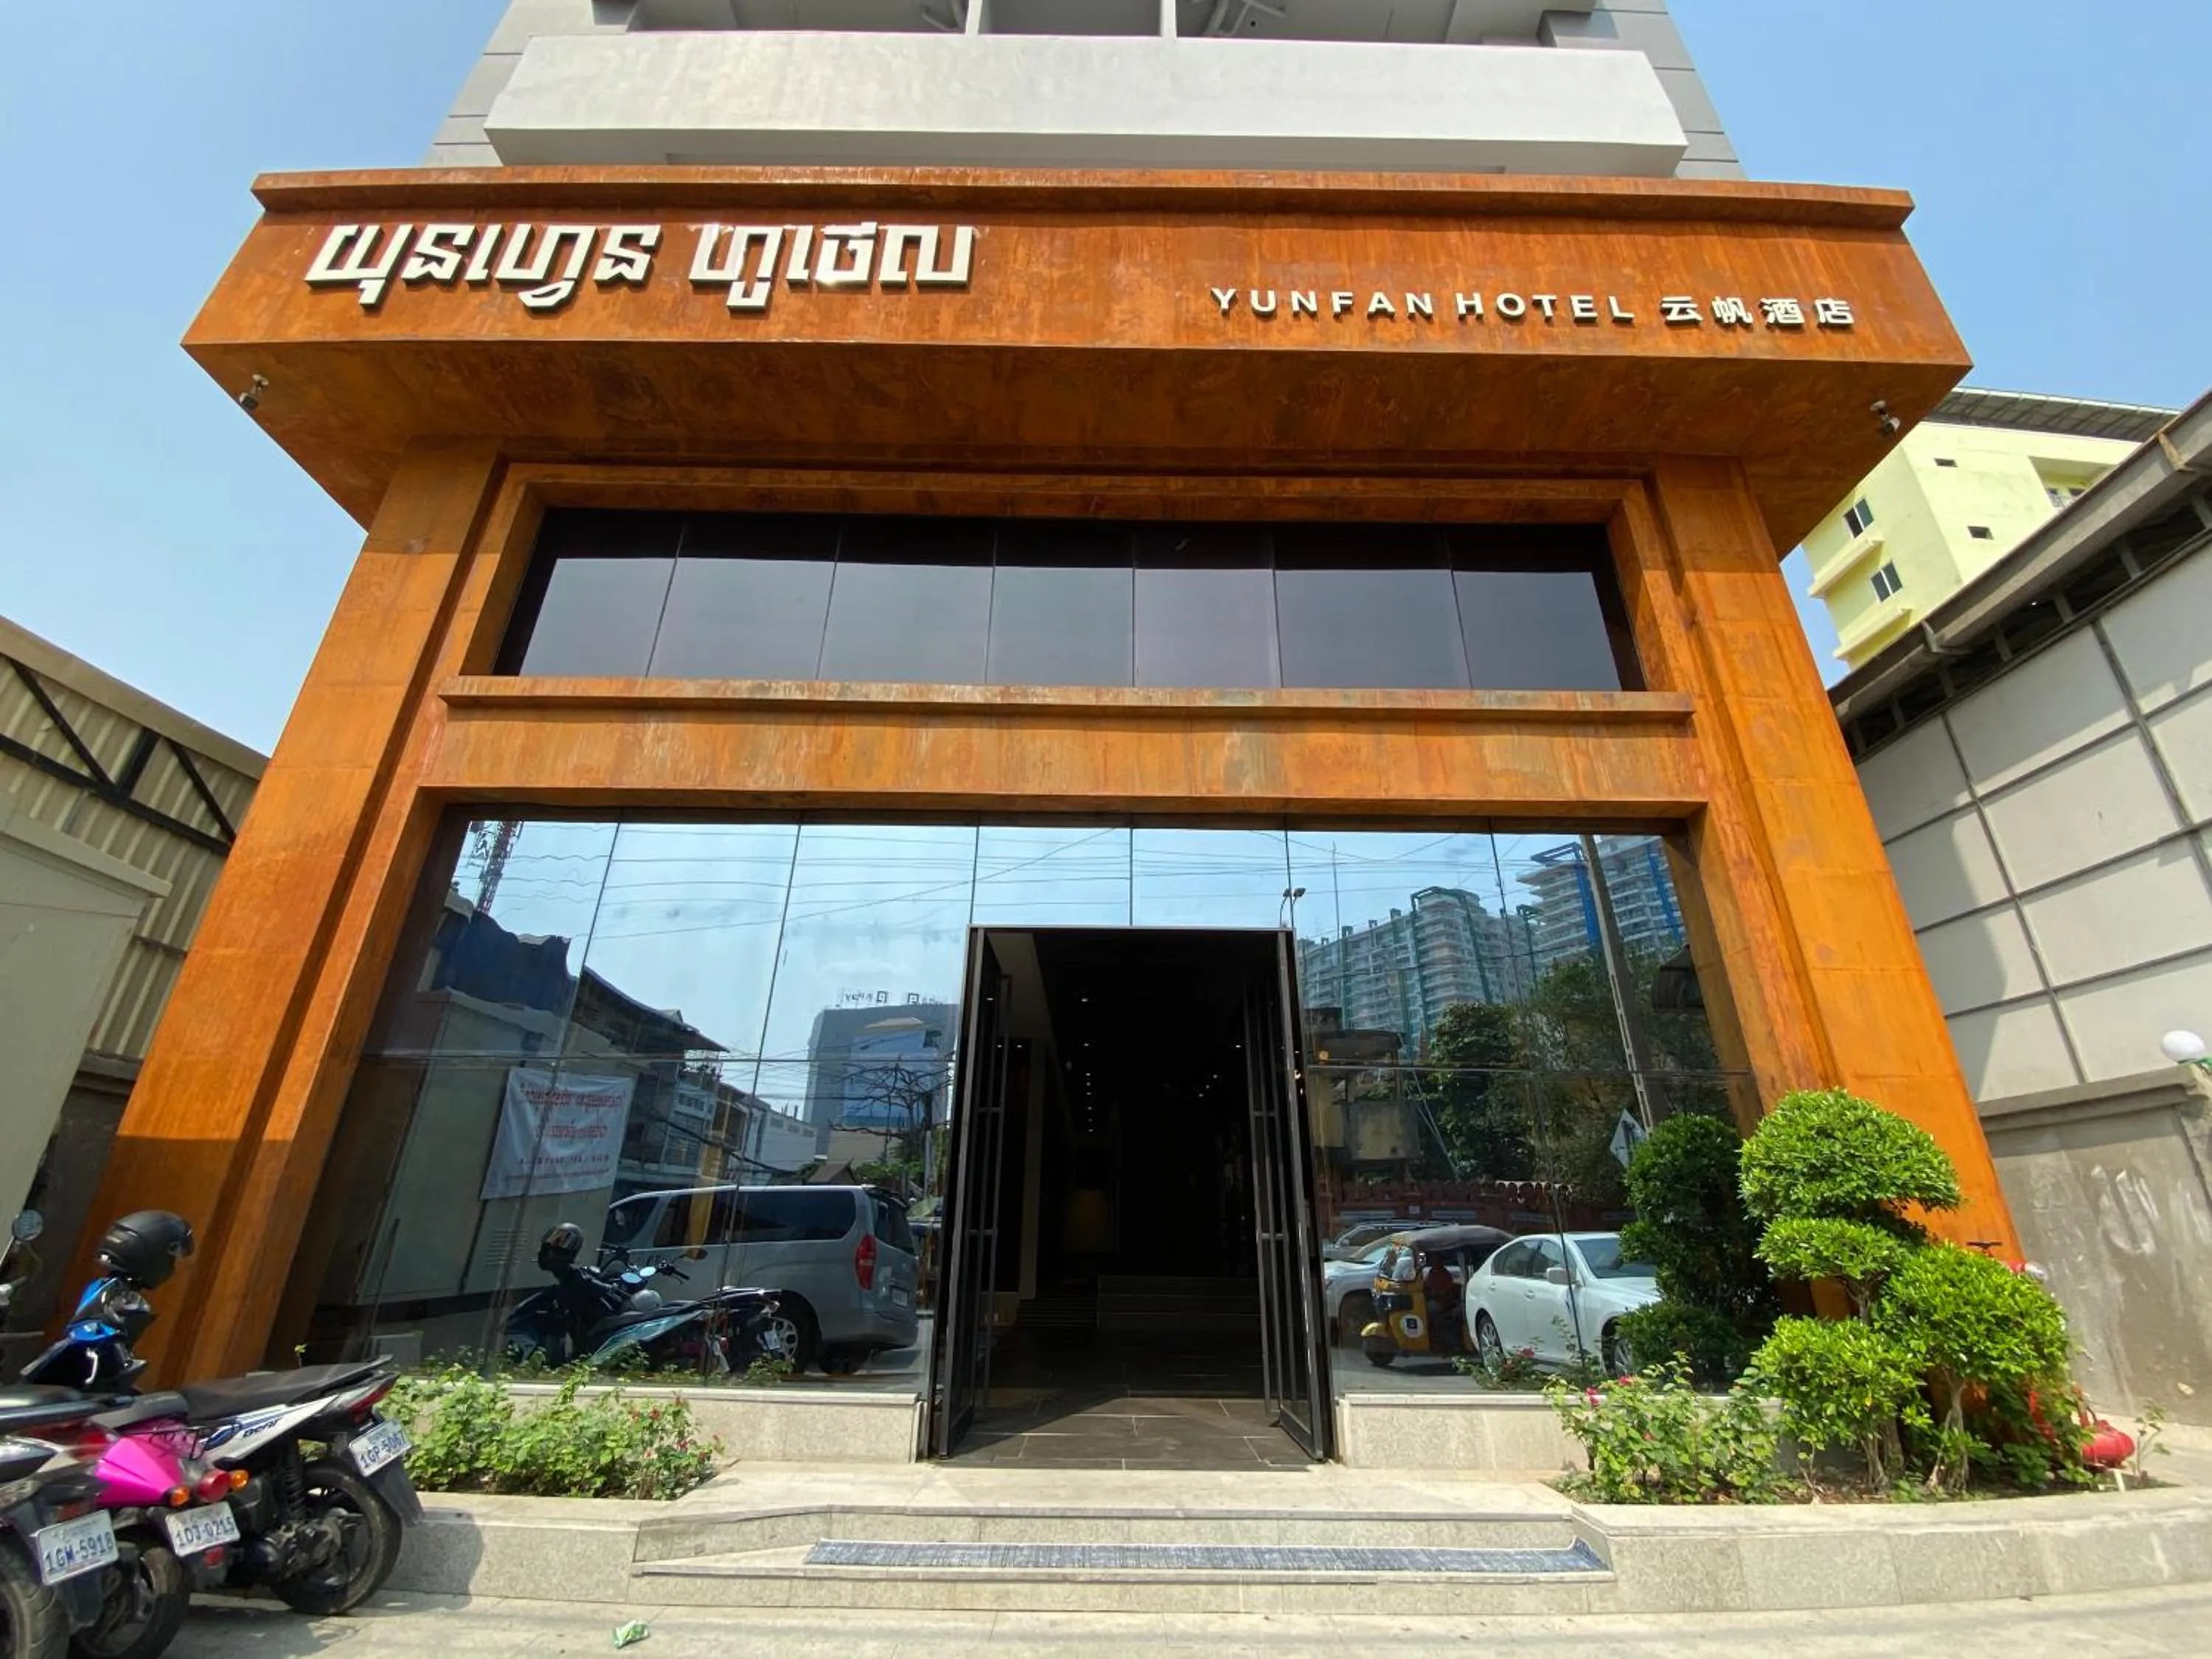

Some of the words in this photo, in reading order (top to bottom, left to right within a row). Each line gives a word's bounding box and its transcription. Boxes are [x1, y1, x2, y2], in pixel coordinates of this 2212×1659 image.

[1211, 288, 1434, 318] YUNFAN
[1455, 292, 1635, 323] HOTEL
[1660, 296, 1854, 324] 云帆酒店
